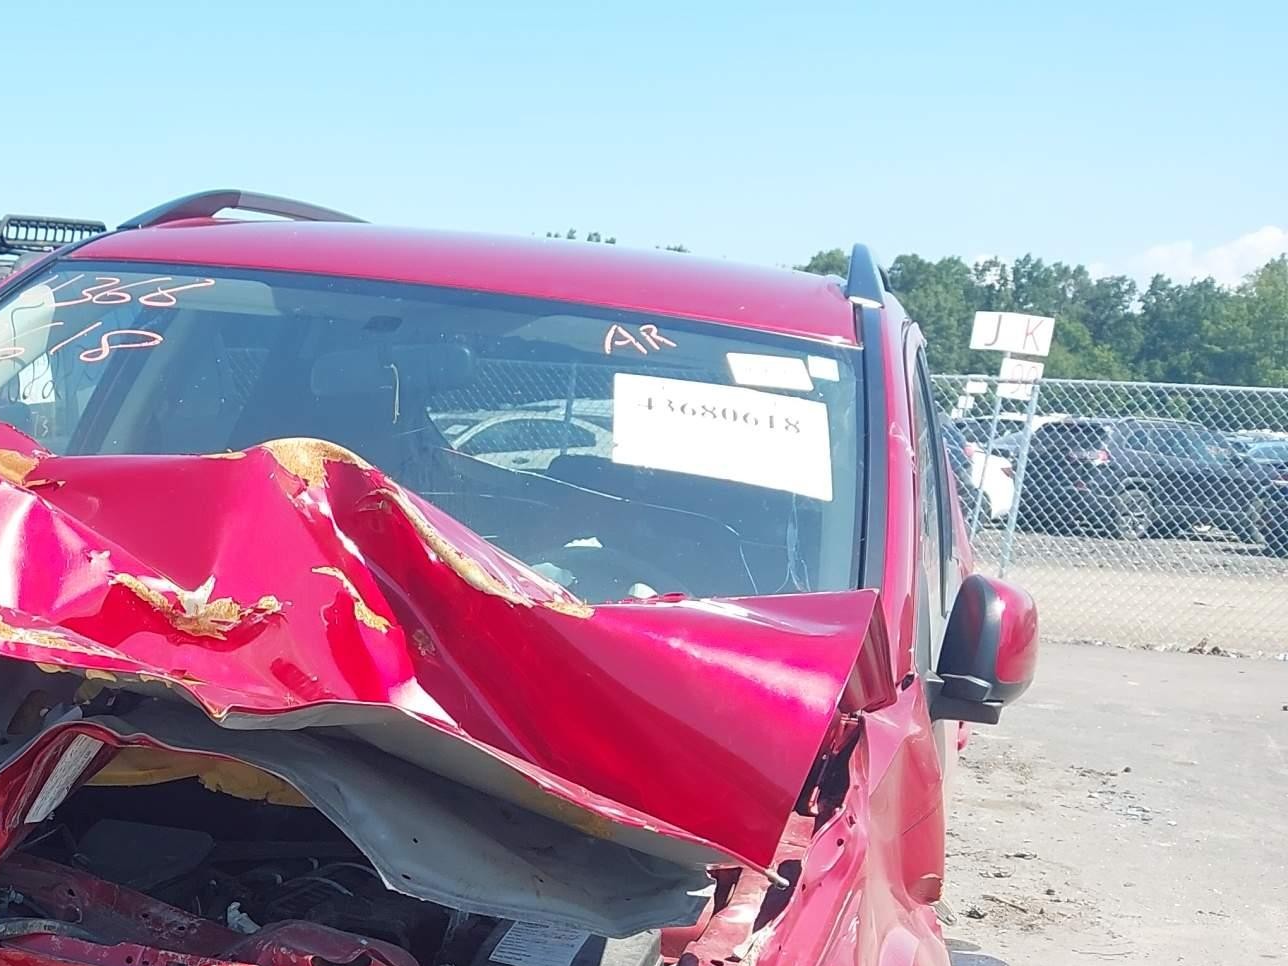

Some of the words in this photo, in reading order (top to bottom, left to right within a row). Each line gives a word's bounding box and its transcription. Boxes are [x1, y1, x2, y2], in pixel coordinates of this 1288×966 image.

[604, 324, 678, 355] AR
[984, 314, 1003, 347] J
[1022, 317, 1045, 352] K
[633, 396, 802, 435] 43680618
